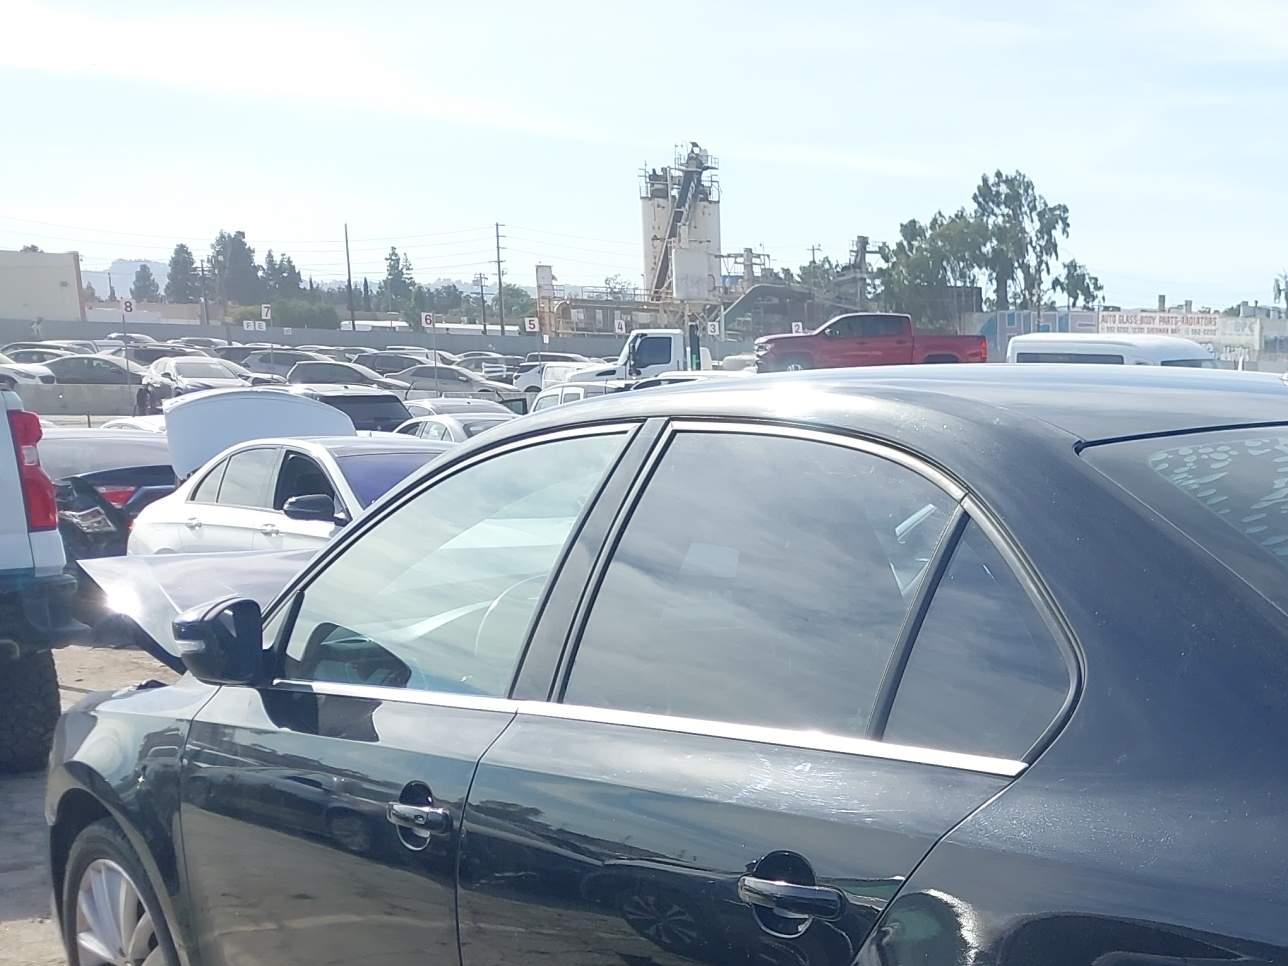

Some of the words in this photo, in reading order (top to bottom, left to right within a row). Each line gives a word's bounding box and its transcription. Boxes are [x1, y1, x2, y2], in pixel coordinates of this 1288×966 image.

[124, 300, 133, 313] 8
[263, 306, 270, 318] 7
[424, 314, 432, 325] 6
[528, 319, 536, 330] 5
[617, 321, 624, 332] 4
[709, 324, 717, 333] 3
[793, 324, 800, 333] 2
